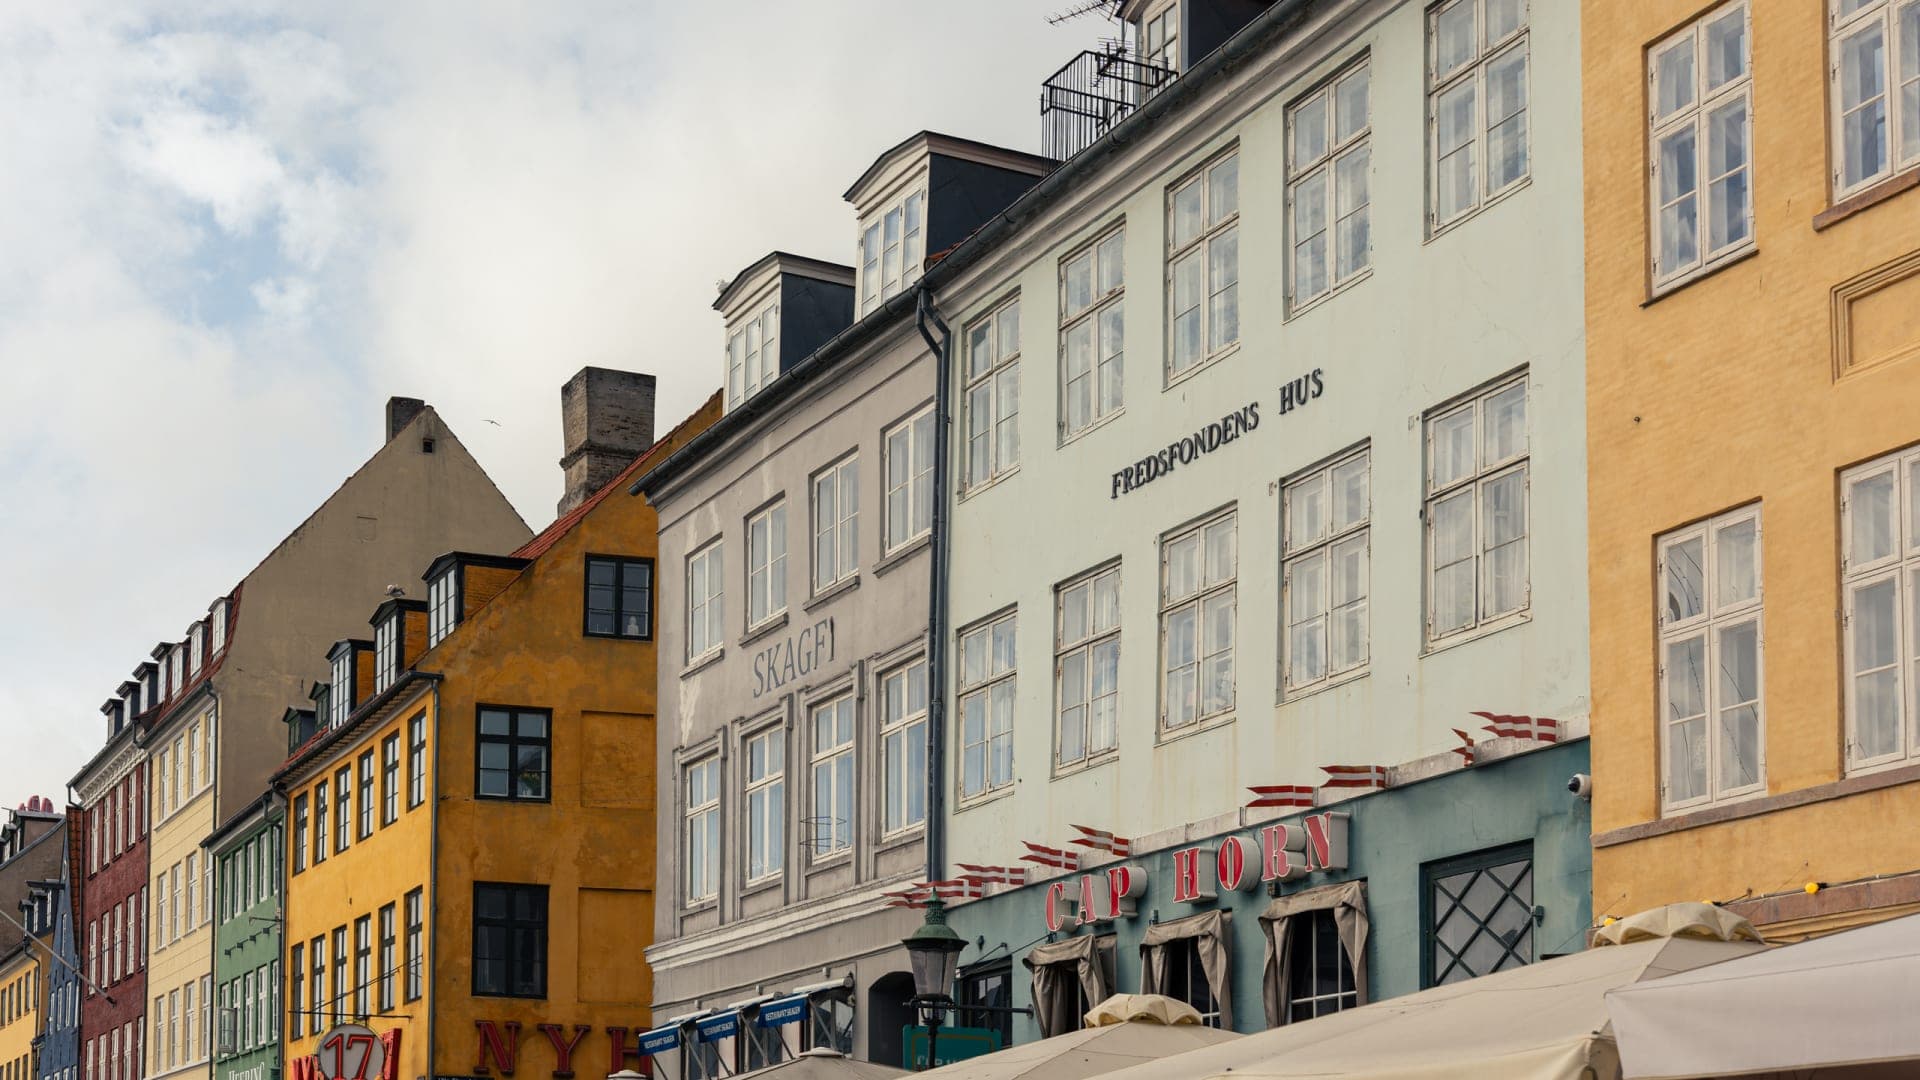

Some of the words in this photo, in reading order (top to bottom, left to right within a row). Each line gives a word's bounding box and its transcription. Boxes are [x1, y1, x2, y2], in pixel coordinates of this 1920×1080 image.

[1110, 401, 1260, 500] FREDSFONDENS
[1278, 368, 1325, 415] HUS
[1045, 865, 1131, 933] CAP
[1172, 811, 1333, 904] HORN
[324, 1032, 376, 1080] 17
